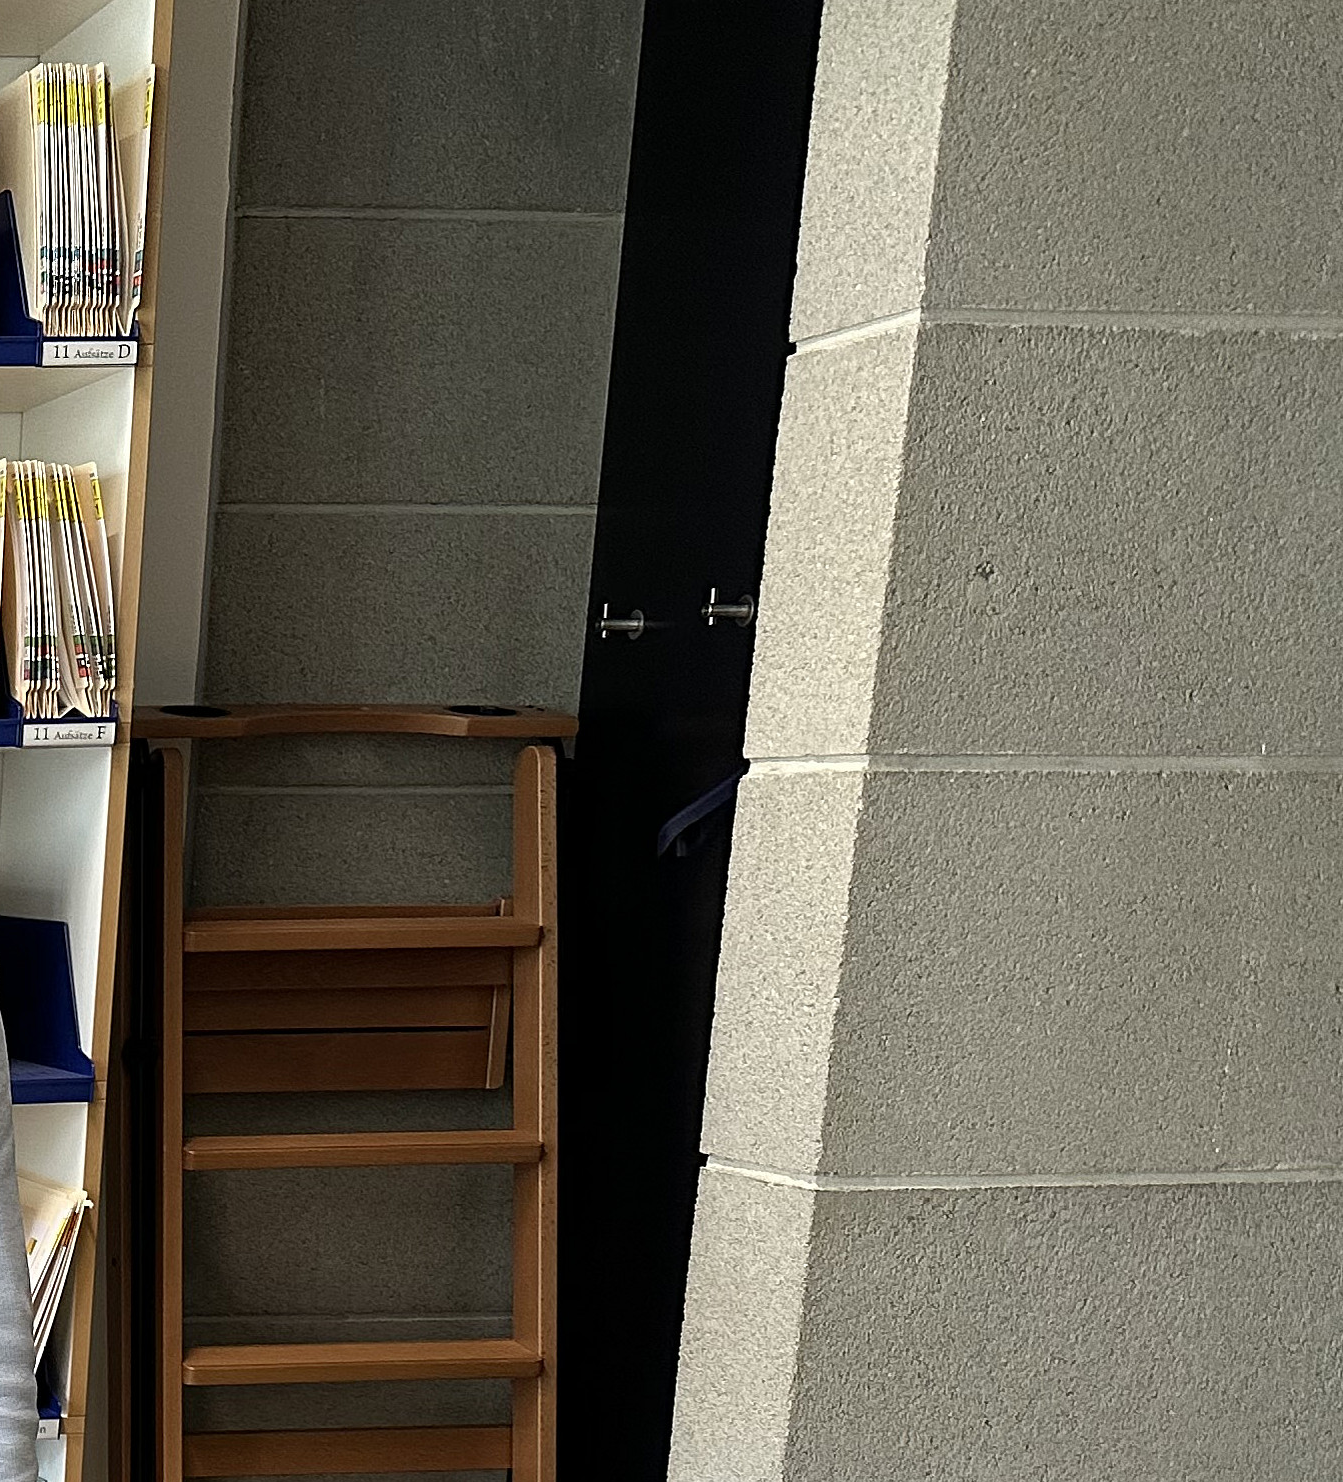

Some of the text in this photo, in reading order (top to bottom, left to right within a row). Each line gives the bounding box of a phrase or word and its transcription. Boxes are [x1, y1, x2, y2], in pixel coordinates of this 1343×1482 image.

[54, 345, 69, 359] 11
[118, 343, 131, 359] D
[34, 726, 106, 742] 11 Aufsätze F
